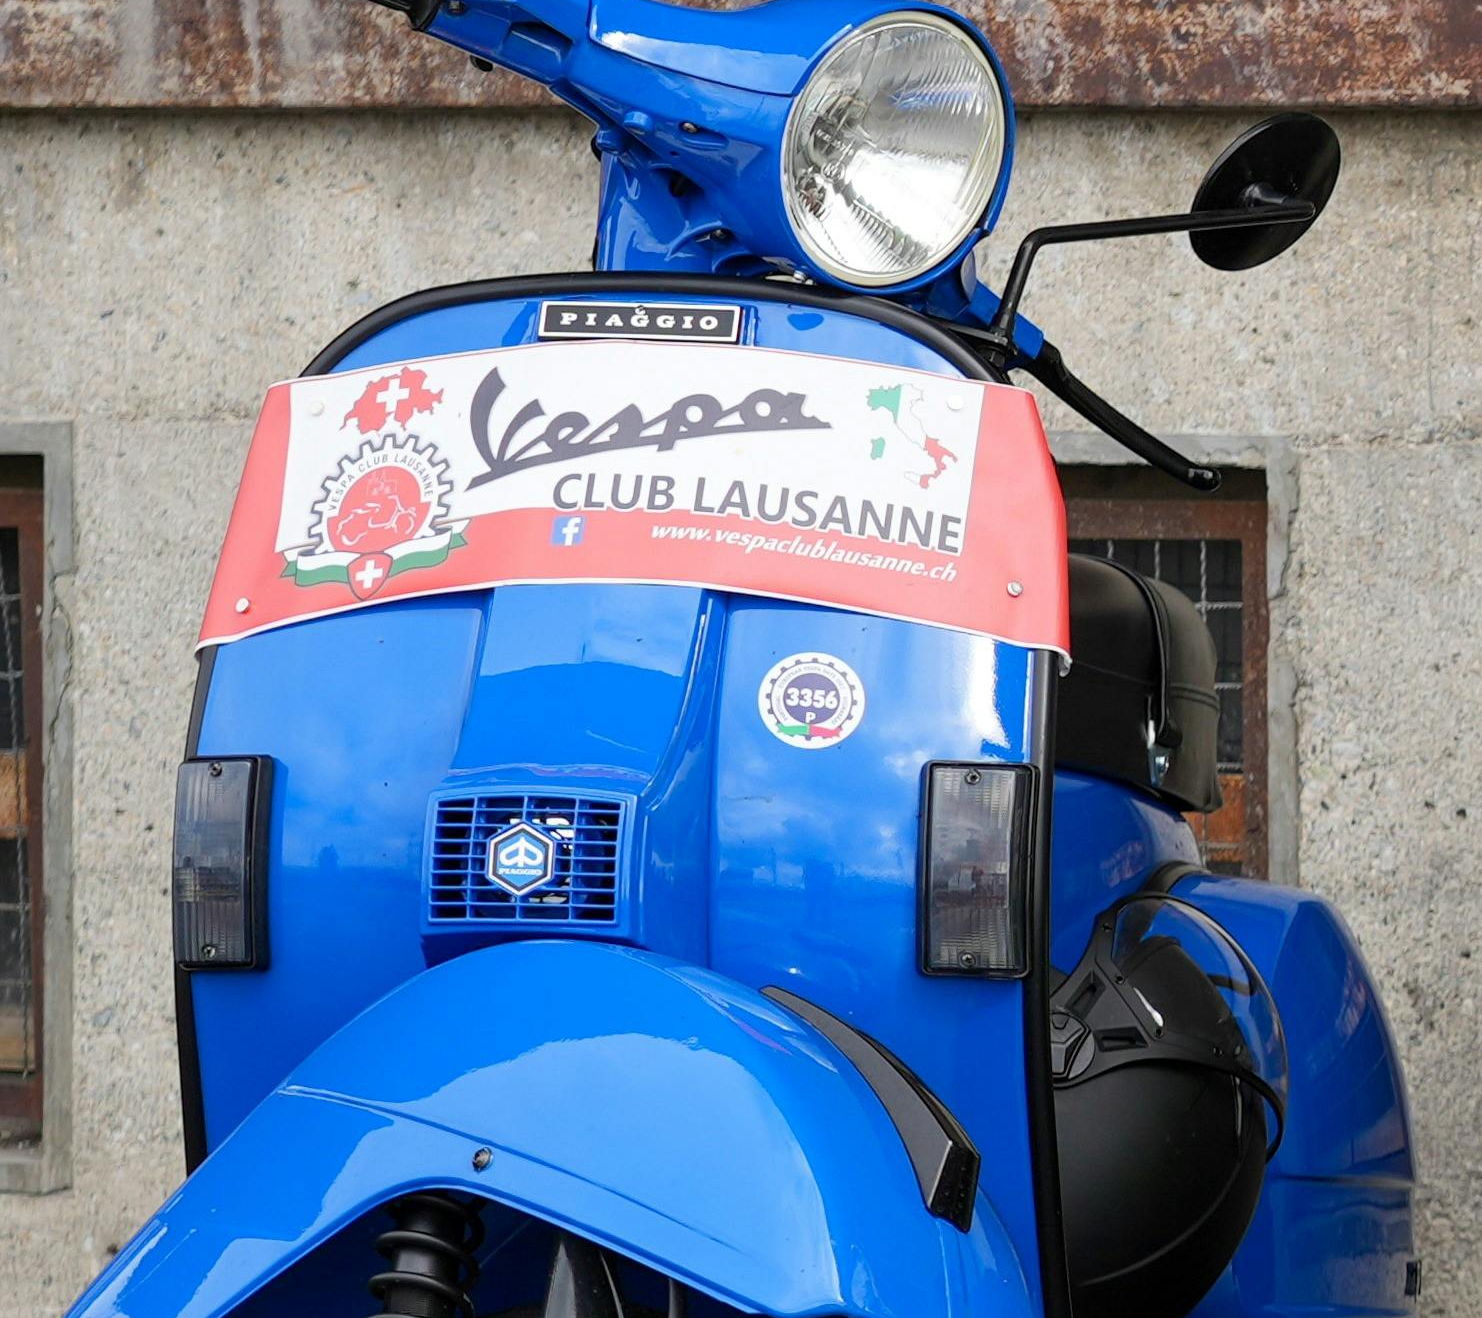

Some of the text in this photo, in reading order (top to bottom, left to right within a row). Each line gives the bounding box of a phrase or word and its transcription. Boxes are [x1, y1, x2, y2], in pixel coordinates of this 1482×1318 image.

[561, 309, 719, 332] PIAGGIO
[465, 367, 832, 492] Vespa
[328, 453, 433, 511] VESPA CLUB LAUSANNE
[551, 473, 963, 555] CLUB LAUSANNE
[651, 522, 958, 581] www.vespaclublausanne.ch
[785, 687, 838, 710] 3356
[805, 712, 817, 724] P
[499, 867, 543, 876] PIAGGIO
